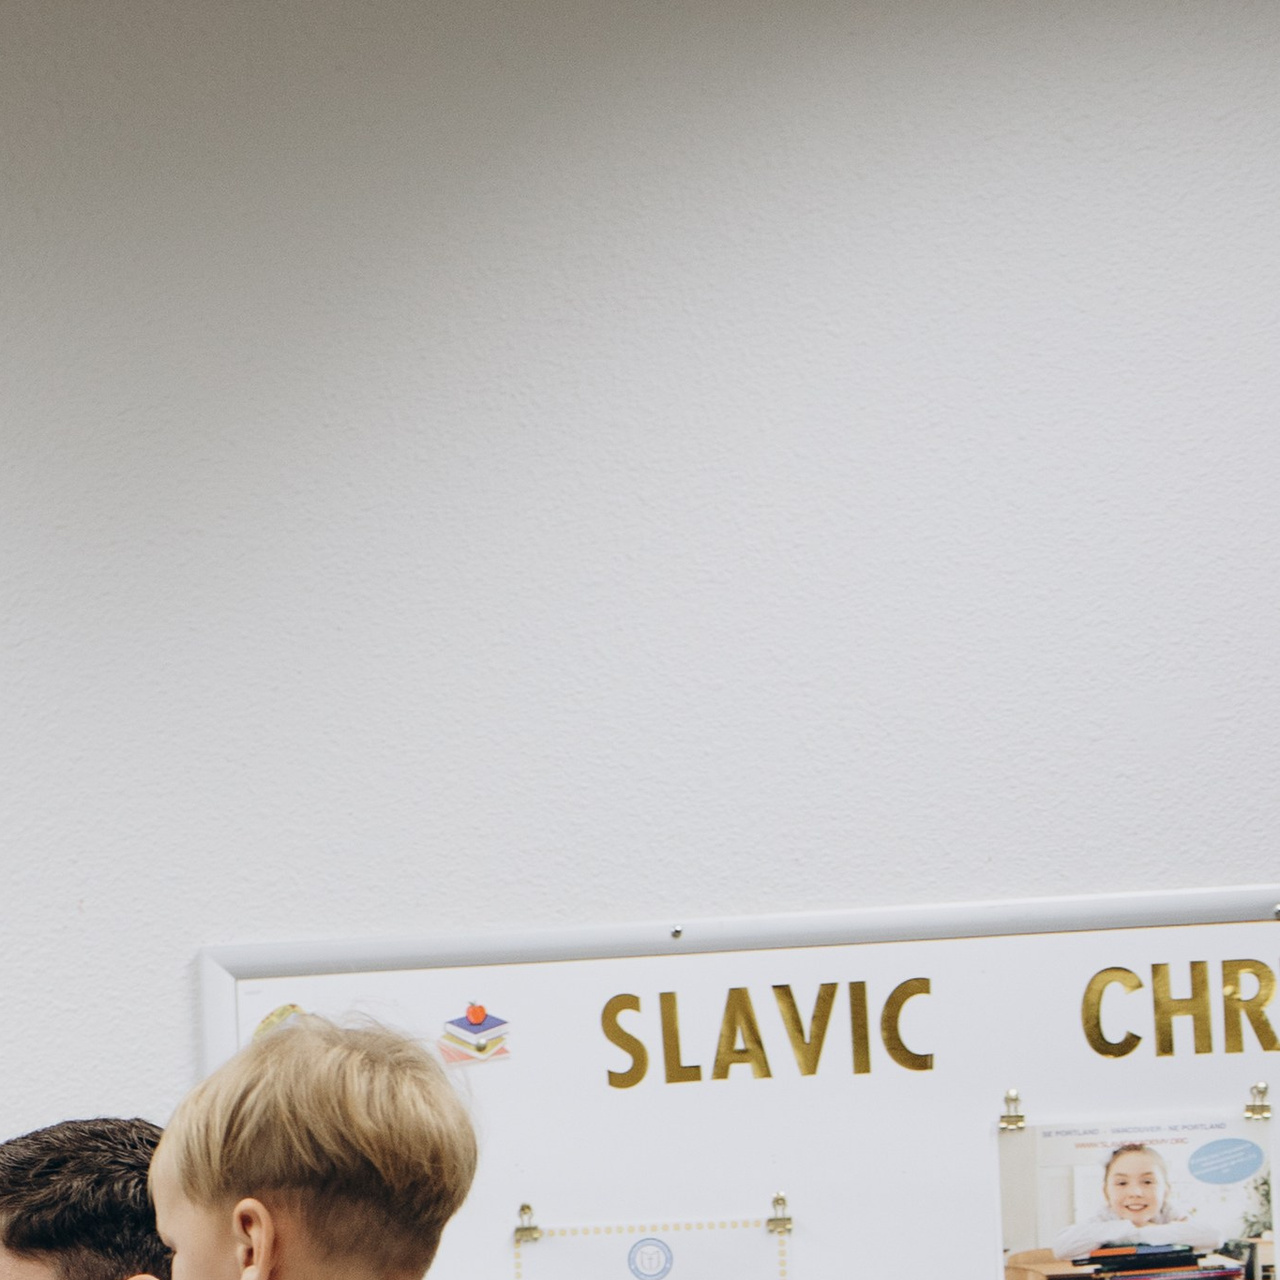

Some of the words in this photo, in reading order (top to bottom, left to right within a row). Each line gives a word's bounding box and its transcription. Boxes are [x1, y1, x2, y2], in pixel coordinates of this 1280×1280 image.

[601, 977, 934, 1089] SLAVIC
[1080, 958, 1280, 1060] CHR
[1055, 1128, 1099, 1137] PORTLAND
[1111, 1126, 1161, 1134] VANCOUVER
[1181, 1122, 1227, 1131] PORTLAND
